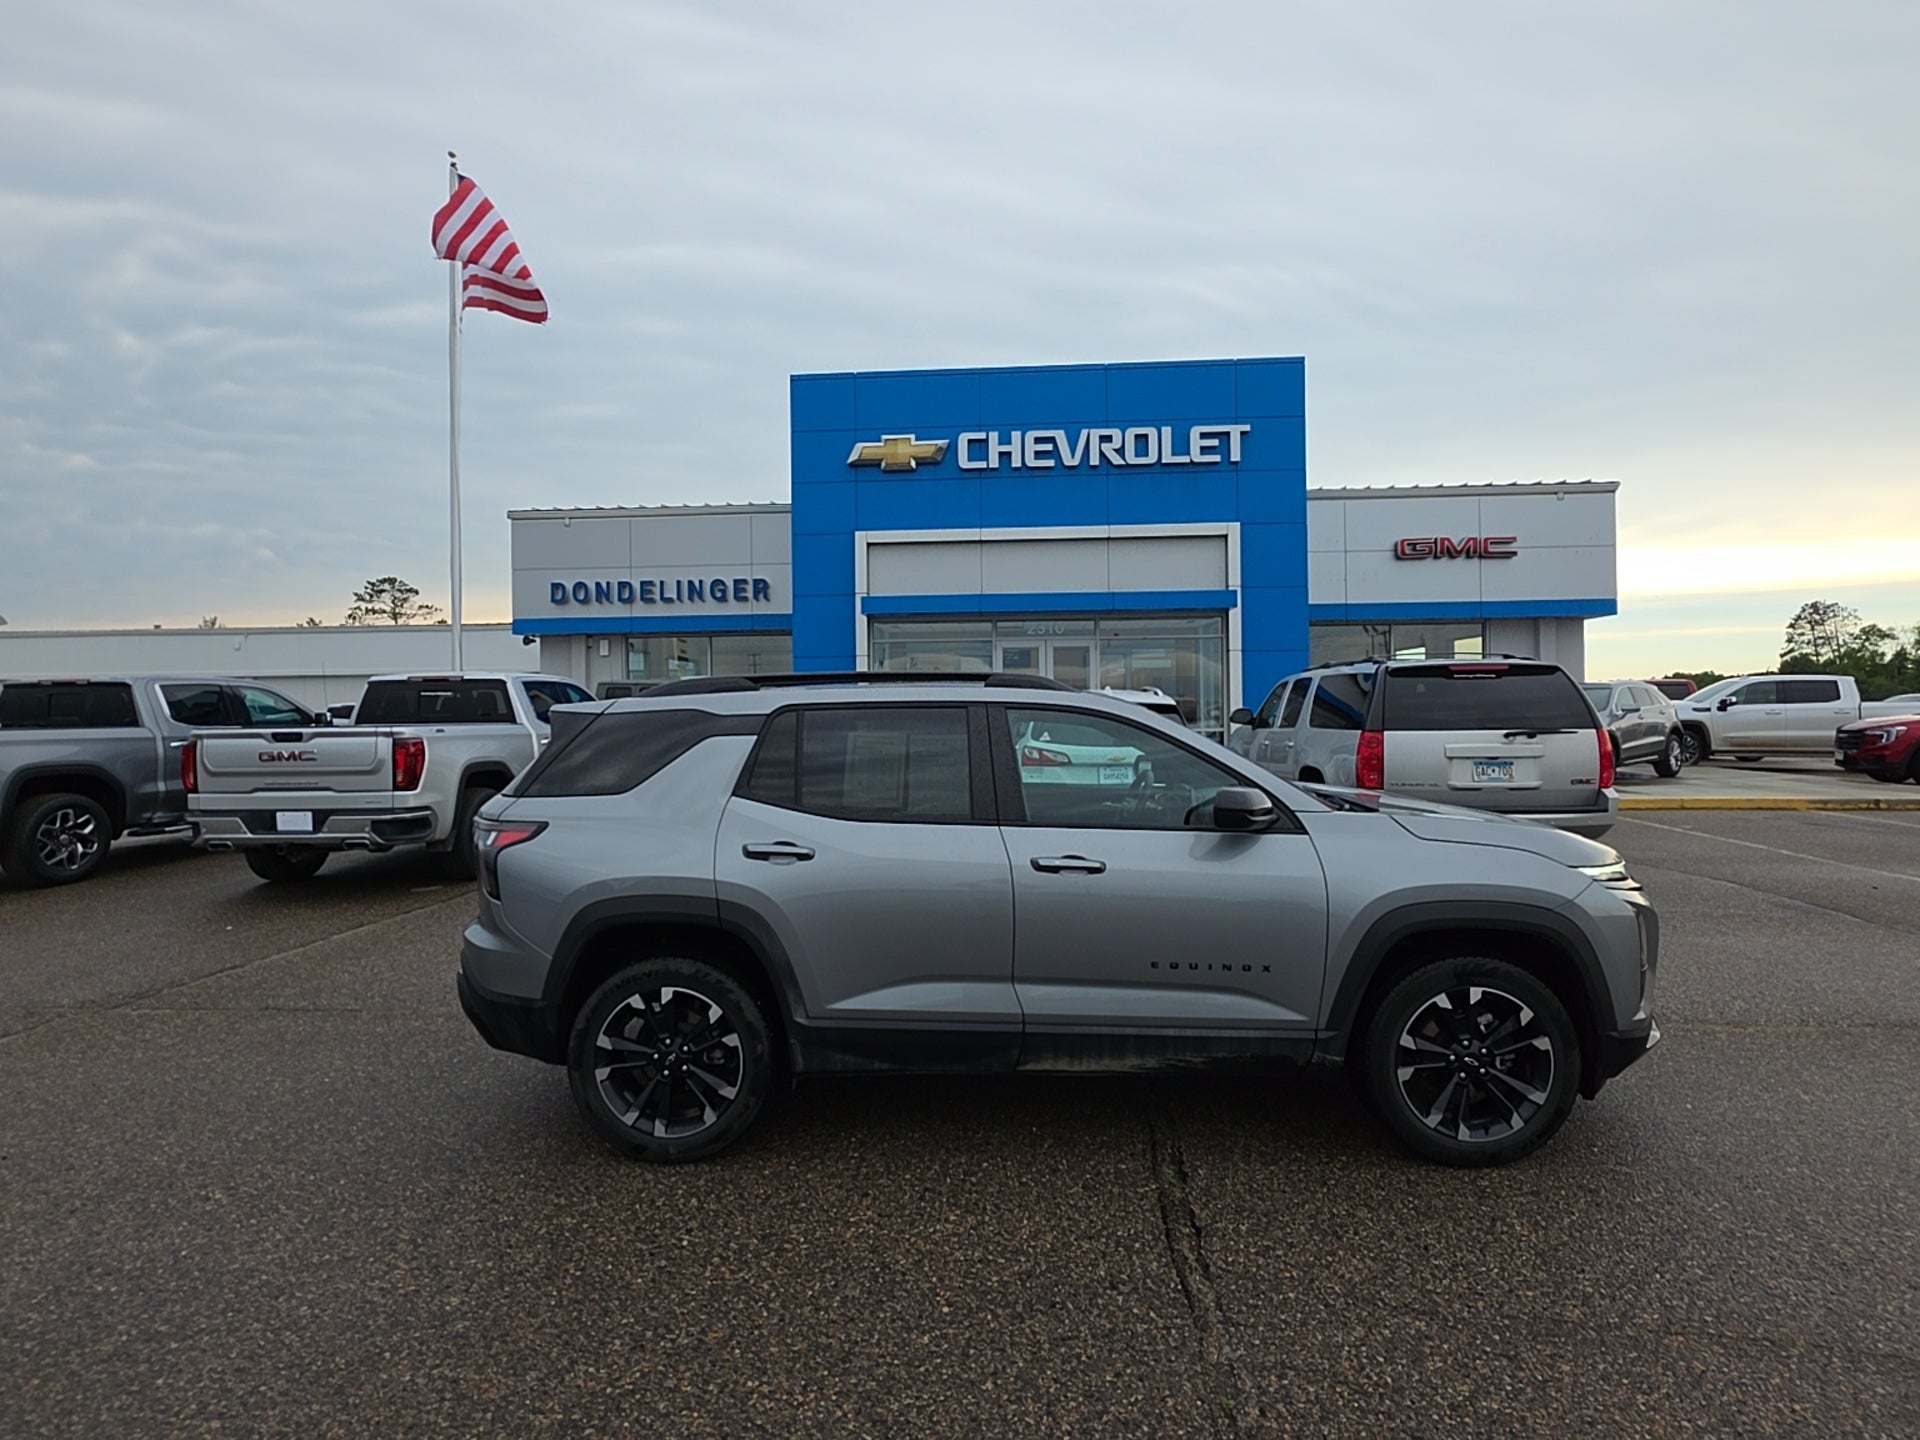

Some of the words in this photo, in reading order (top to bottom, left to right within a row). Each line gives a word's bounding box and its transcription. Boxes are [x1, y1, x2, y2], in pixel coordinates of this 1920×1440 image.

[957, 424, 1251, 469] CHEVROLET
[1394, 536, 1518, 560] GMC
[550, 578, 771, 605] DONDELINGER
[258, 749, 318, 762] GMC
[1150, 961, 1272, 973] EQUINOX
